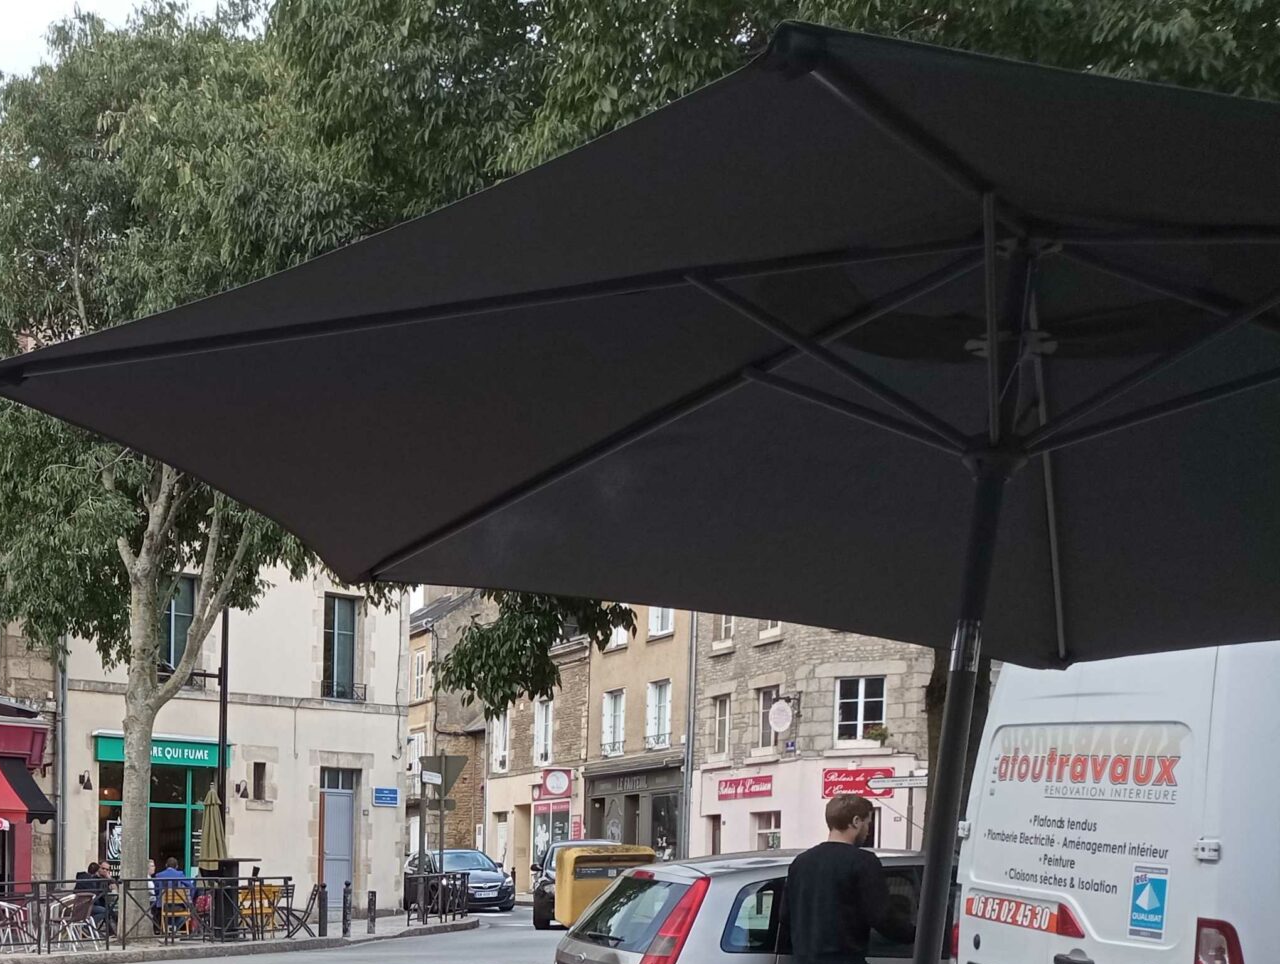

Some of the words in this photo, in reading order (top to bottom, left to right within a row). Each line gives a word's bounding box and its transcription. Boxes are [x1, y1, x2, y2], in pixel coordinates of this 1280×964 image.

[164, 747, 182, 760] QUI
[184, 750, 209, 760] FUME
[998, 747, 1181, 786] atoutravaux
[1044, 785, 1106, 798] RENOVATION
[1110, 788, 1178, 801] INTERIEURE
[1033, 815, 1065, 829] Plafonds
[1067, 817, 1098, 832] tendus
[987, 829, 1018, 843] Plomberie
[1062, 836, 1127, 855] Aménagement
[1128, 842, 1169, 860] intérieur
[1042, 853, 1075, 869] Peinture
[1008, 868, 1038, 884] Cloisons
[1039, 872, 1067, 888] sèches
[1069, 877, 1075, 888] &
[1077, 877, 1118, 895] Isolation
[972, 895, 985, 916] 06
[985, 898, 1000, 919] 85
[1000, 900, 1016, 922] 02
[1016, 902, 1031, 926] 45
[1033, 906, 1050, 930] 30
